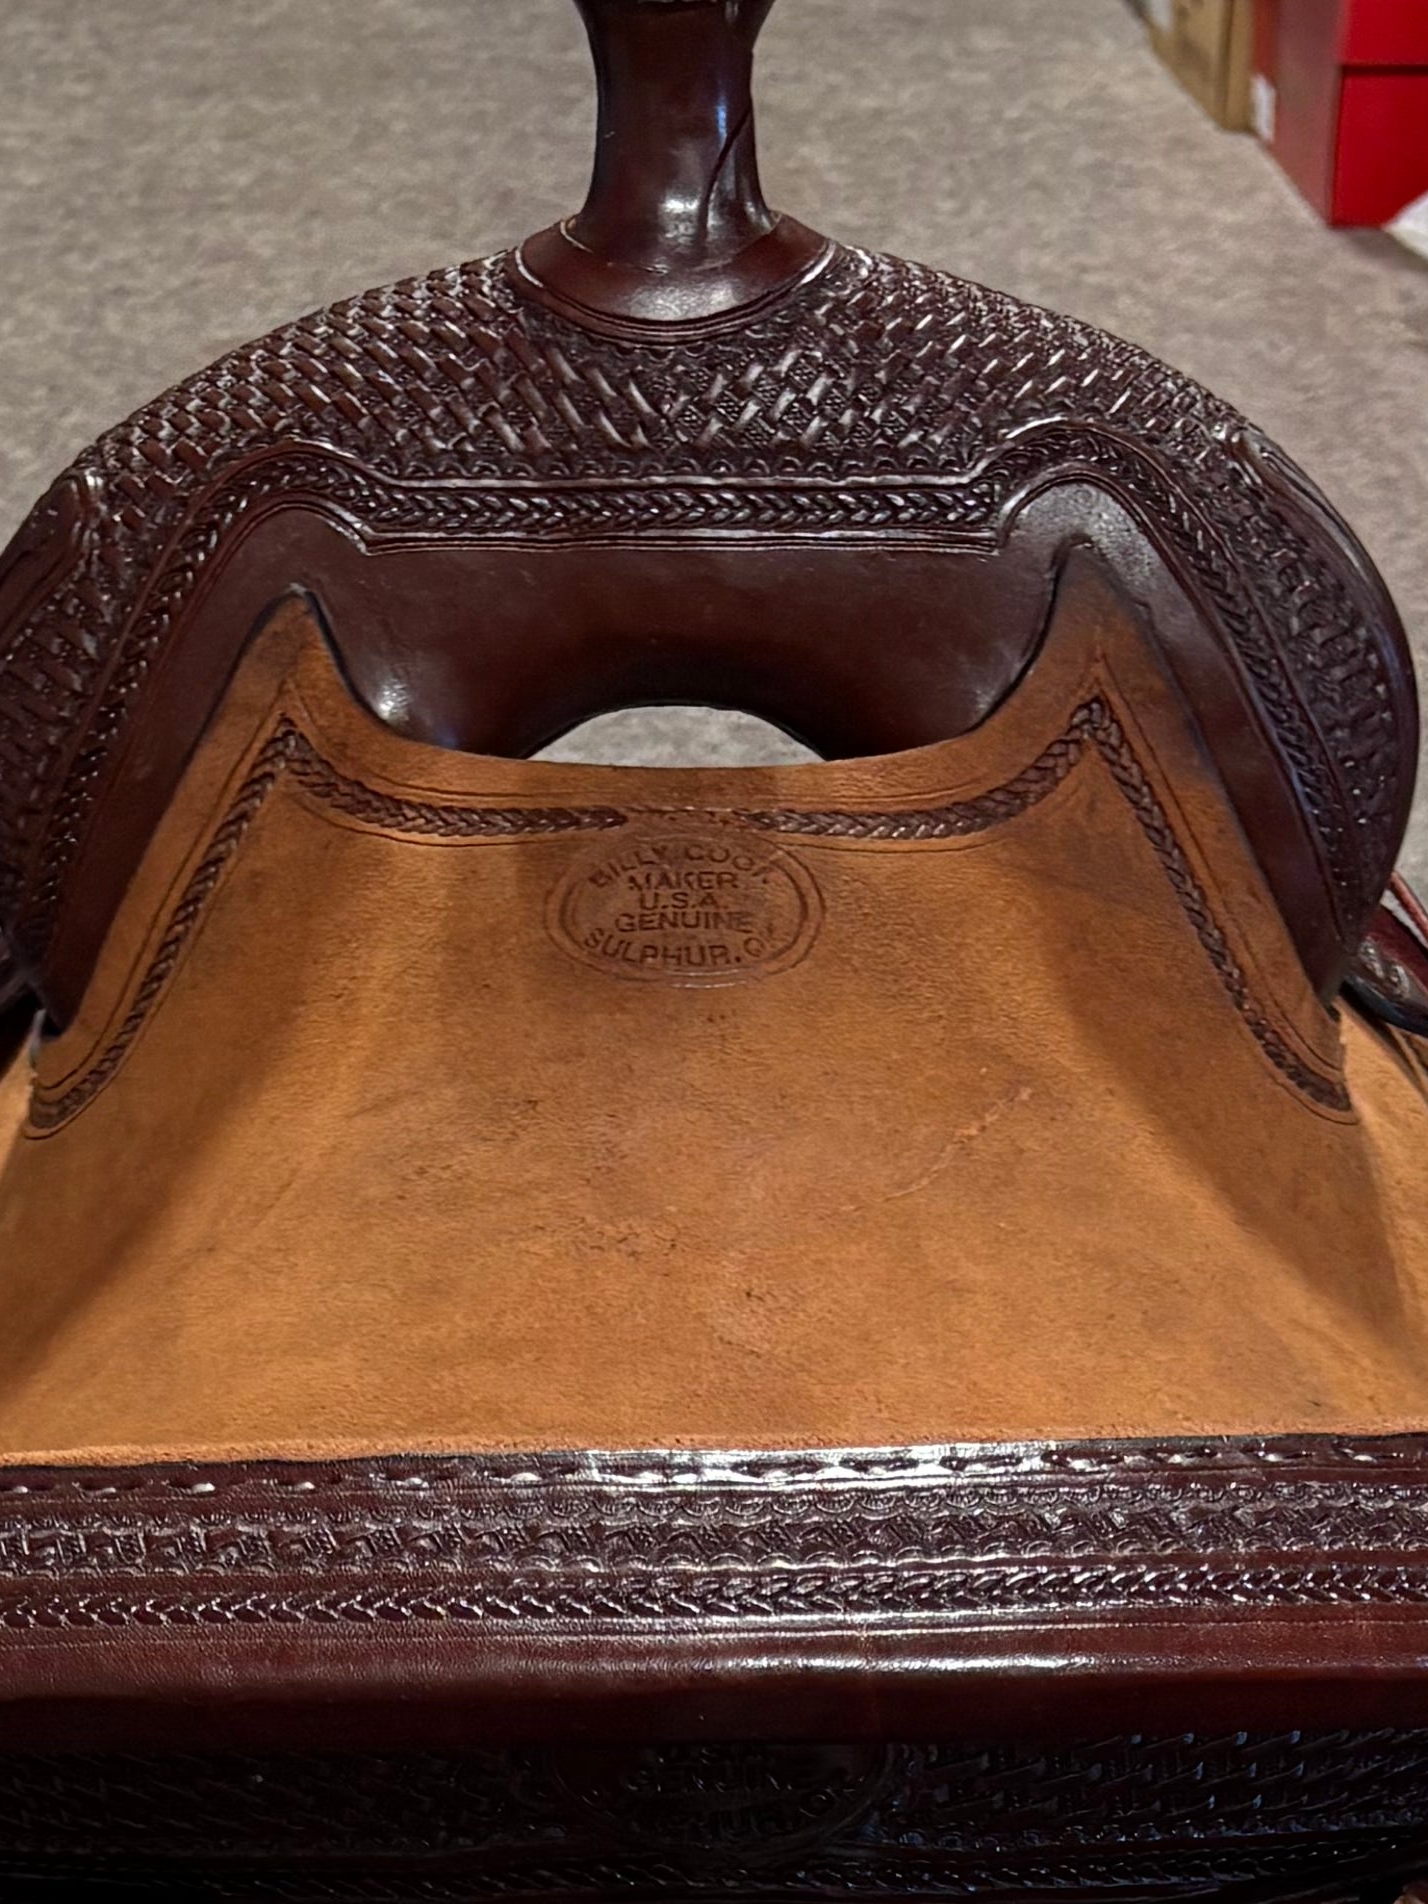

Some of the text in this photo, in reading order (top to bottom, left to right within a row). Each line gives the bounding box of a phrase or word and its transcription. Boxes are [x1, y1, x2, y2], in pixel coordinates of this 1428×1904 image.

[588, 845, 668, 888] BILLY
[629, 870, 738, 892] MAKER
[614, 911, 753, 934] GENUINE
